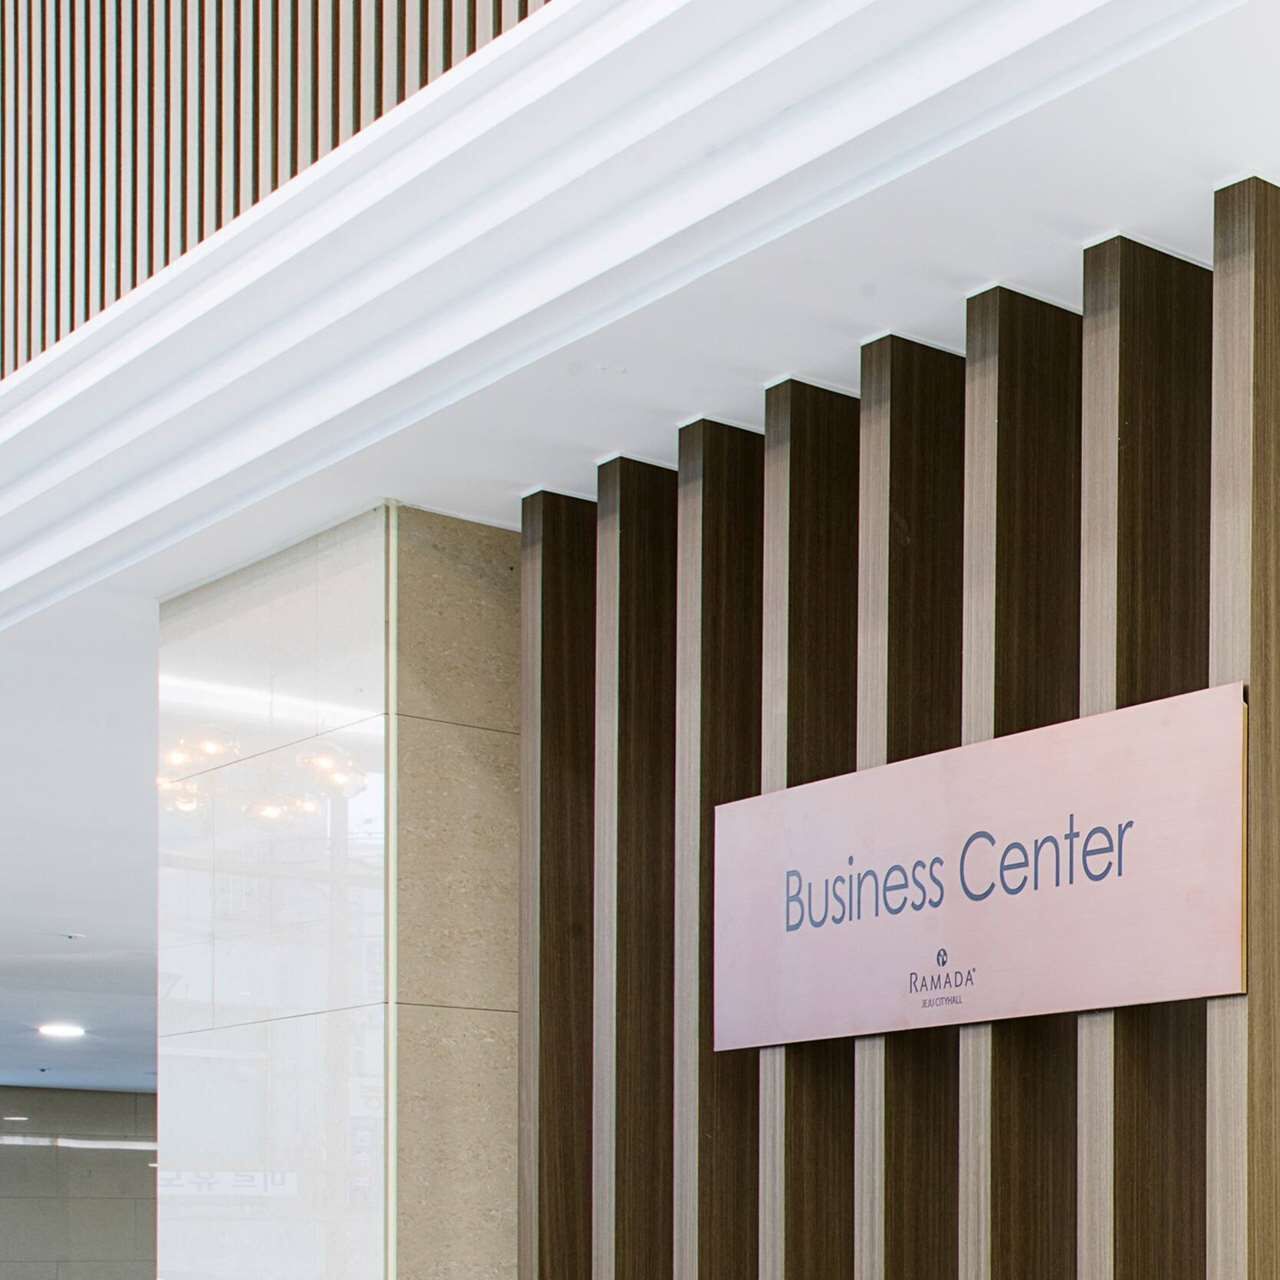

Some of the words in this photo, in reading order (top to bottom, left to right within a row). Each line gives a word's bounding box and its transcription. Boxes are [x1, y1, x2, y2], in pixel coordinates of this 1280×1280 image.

[785, 855, 945, 932] Business
[959, 813, 1135, 902] Center
[909, 969, 974, 994] RAMADA
